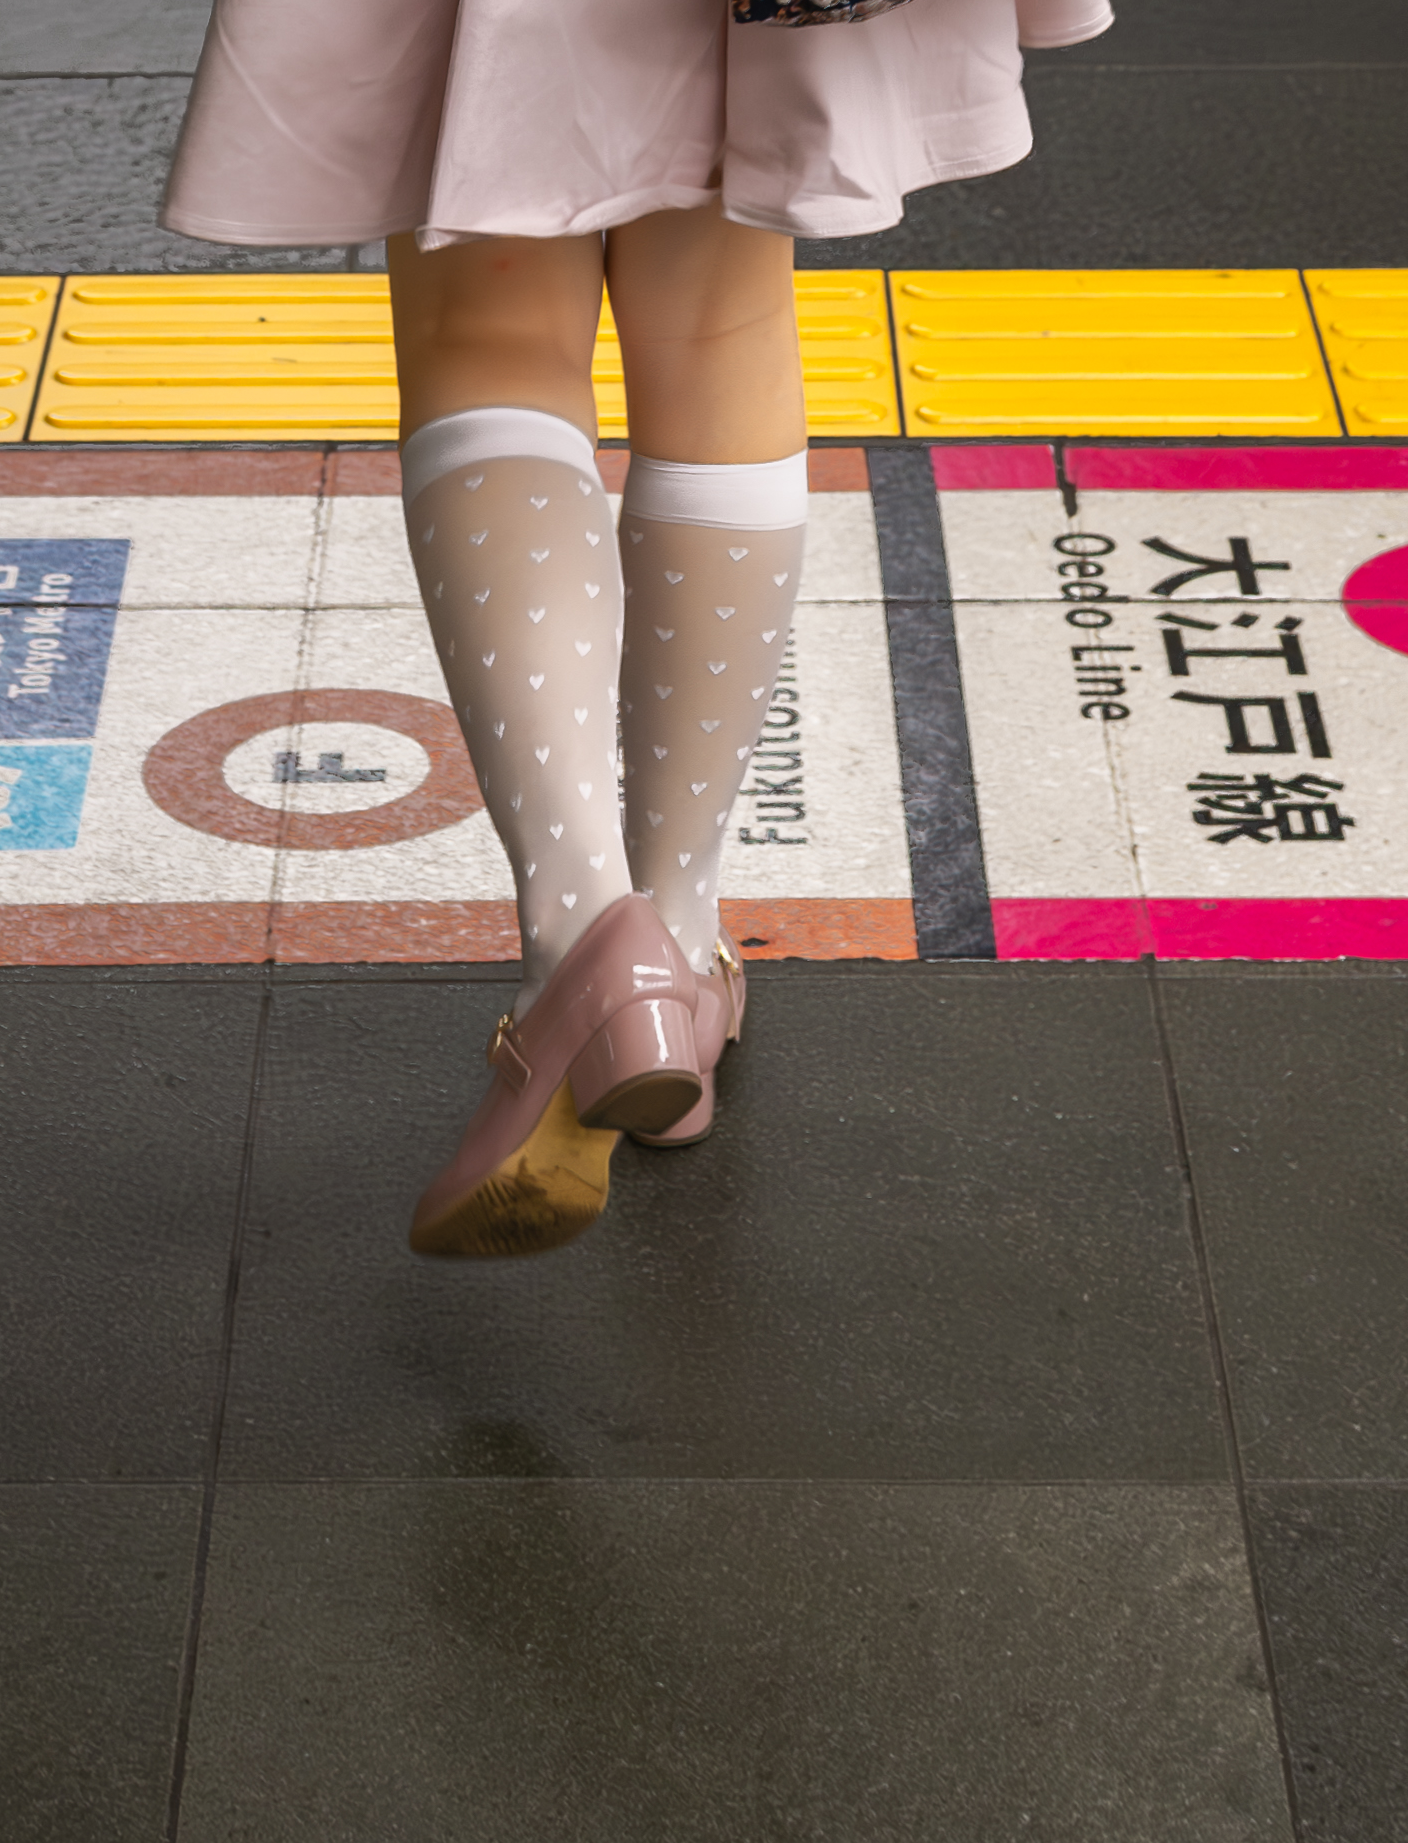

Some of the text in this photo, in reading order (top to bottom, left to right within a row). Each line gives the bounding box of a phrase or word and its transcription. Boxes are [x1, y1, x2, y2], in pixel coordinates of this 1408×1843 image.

[7, 572, 74, 699] Tokyo Metro
[1053, 532, 1142, 721] Oedo Line
[1141, 536, 1356, 845] 大江戸線
[273, 751, 386, 783] F
